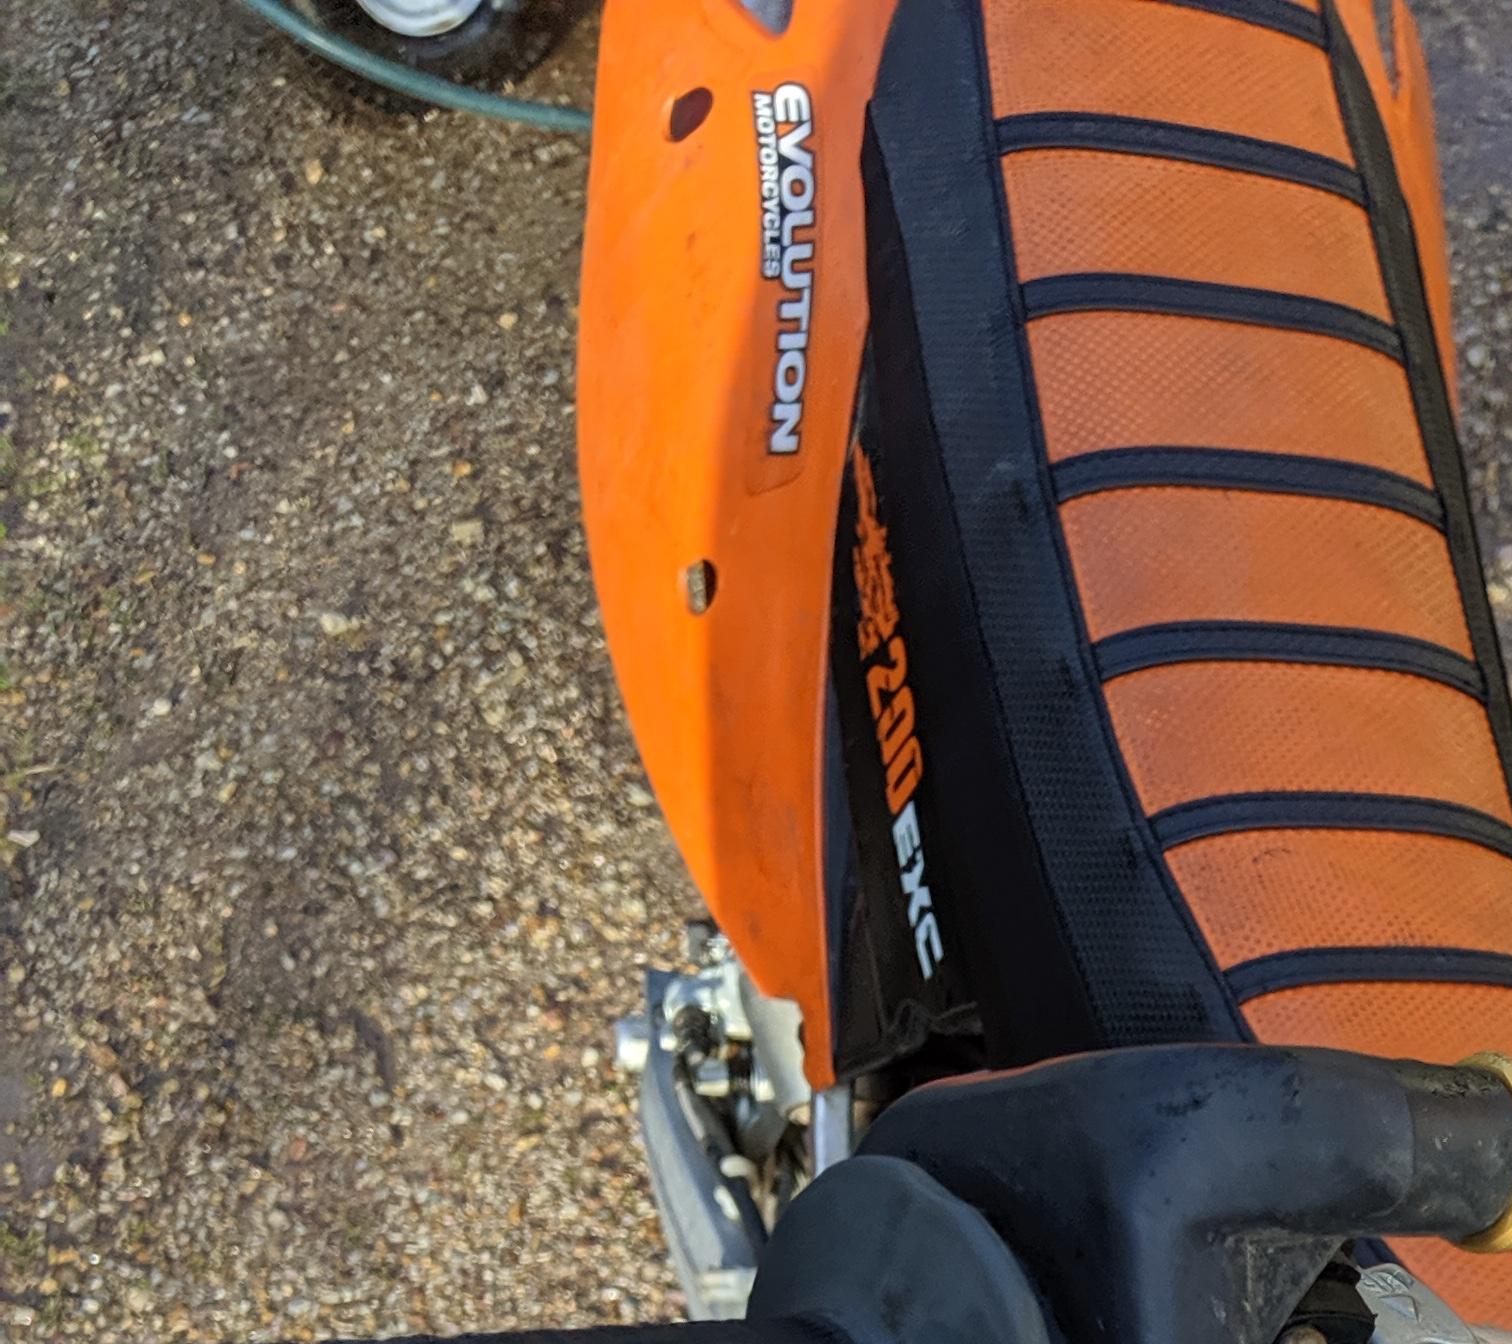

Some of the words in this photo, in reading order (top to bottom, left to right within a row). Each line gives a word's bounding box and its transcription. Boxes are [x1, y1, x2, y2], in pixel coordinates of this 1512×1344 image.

[753, 92, 781, 279] MOTORCYCLES
[769, 83, 816, 453] EVOLUTION
[892, 800, 944, 980] EXC
